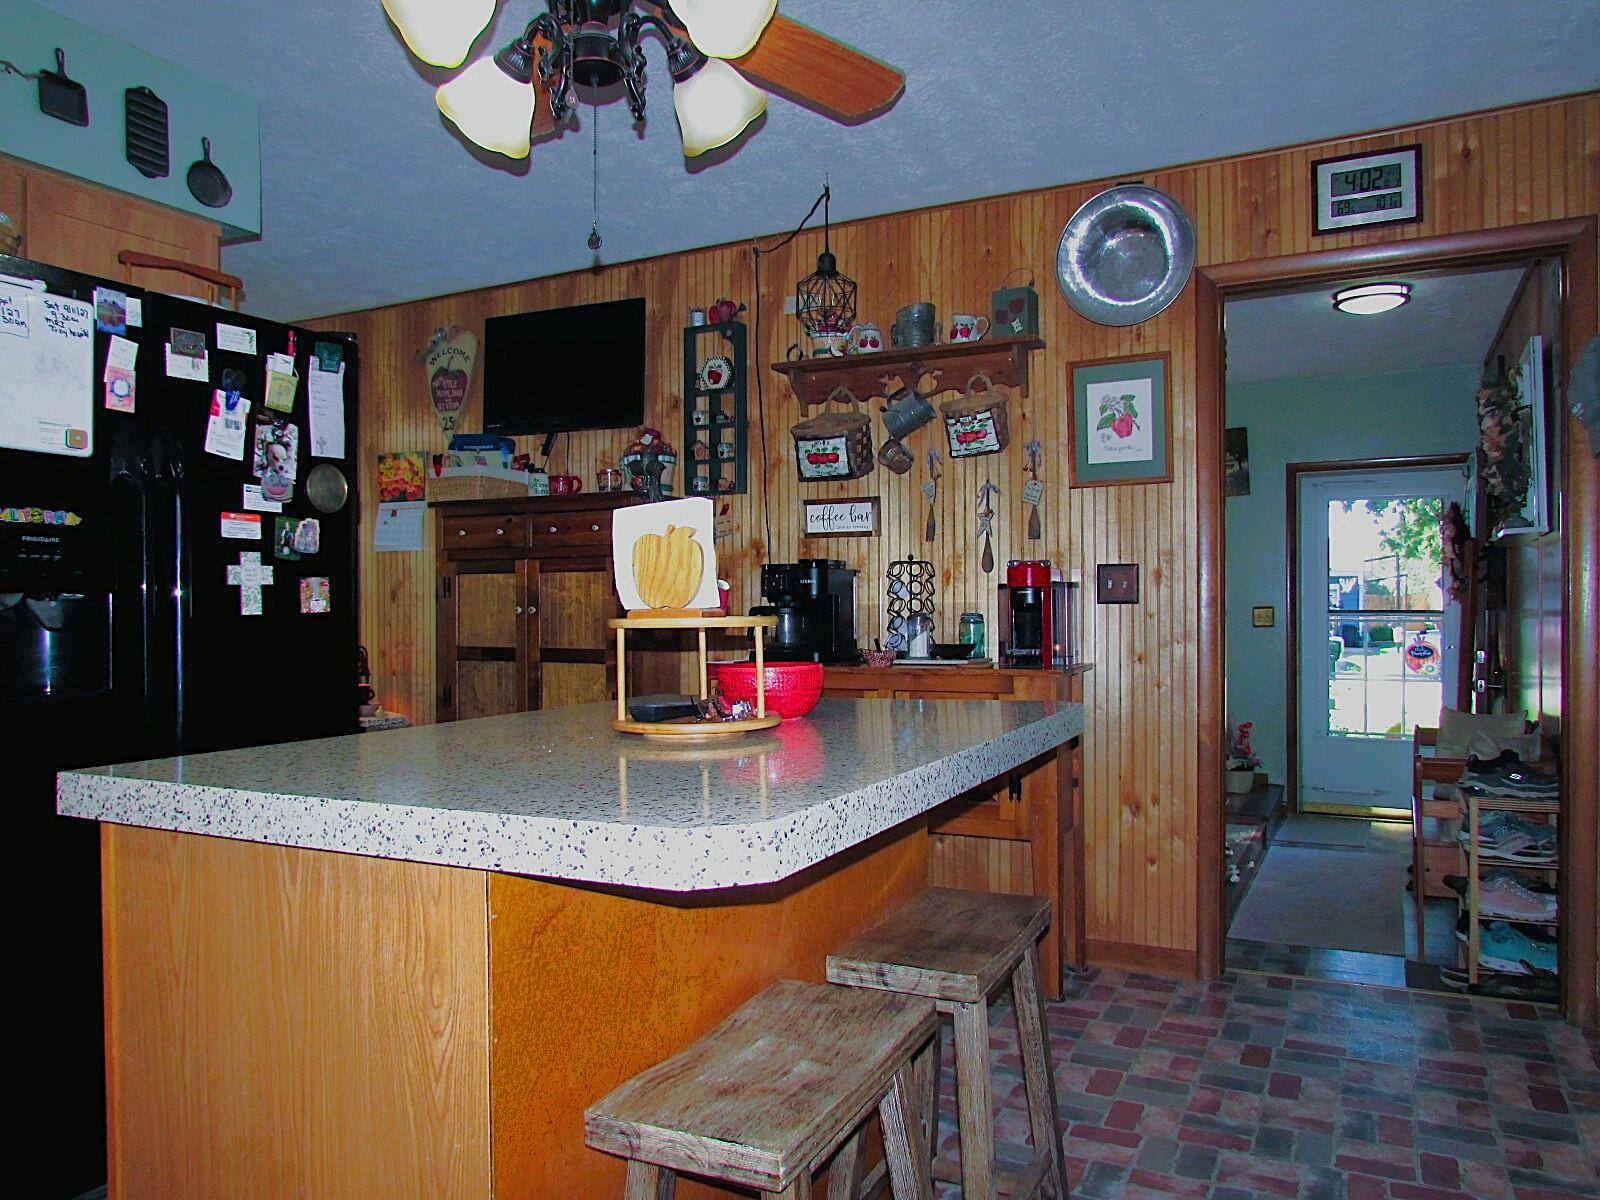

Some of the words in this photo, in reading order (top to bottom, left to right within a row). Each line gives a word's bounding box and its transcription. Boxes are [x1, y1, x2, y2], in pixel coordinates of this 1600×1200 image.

[428, 346, 471, 366] WELCOME
[809, 505, 847, 531] coffee
[849, 504, 872, 522] bar
[21, 535, 60, 543] FRIGIDAIRE
